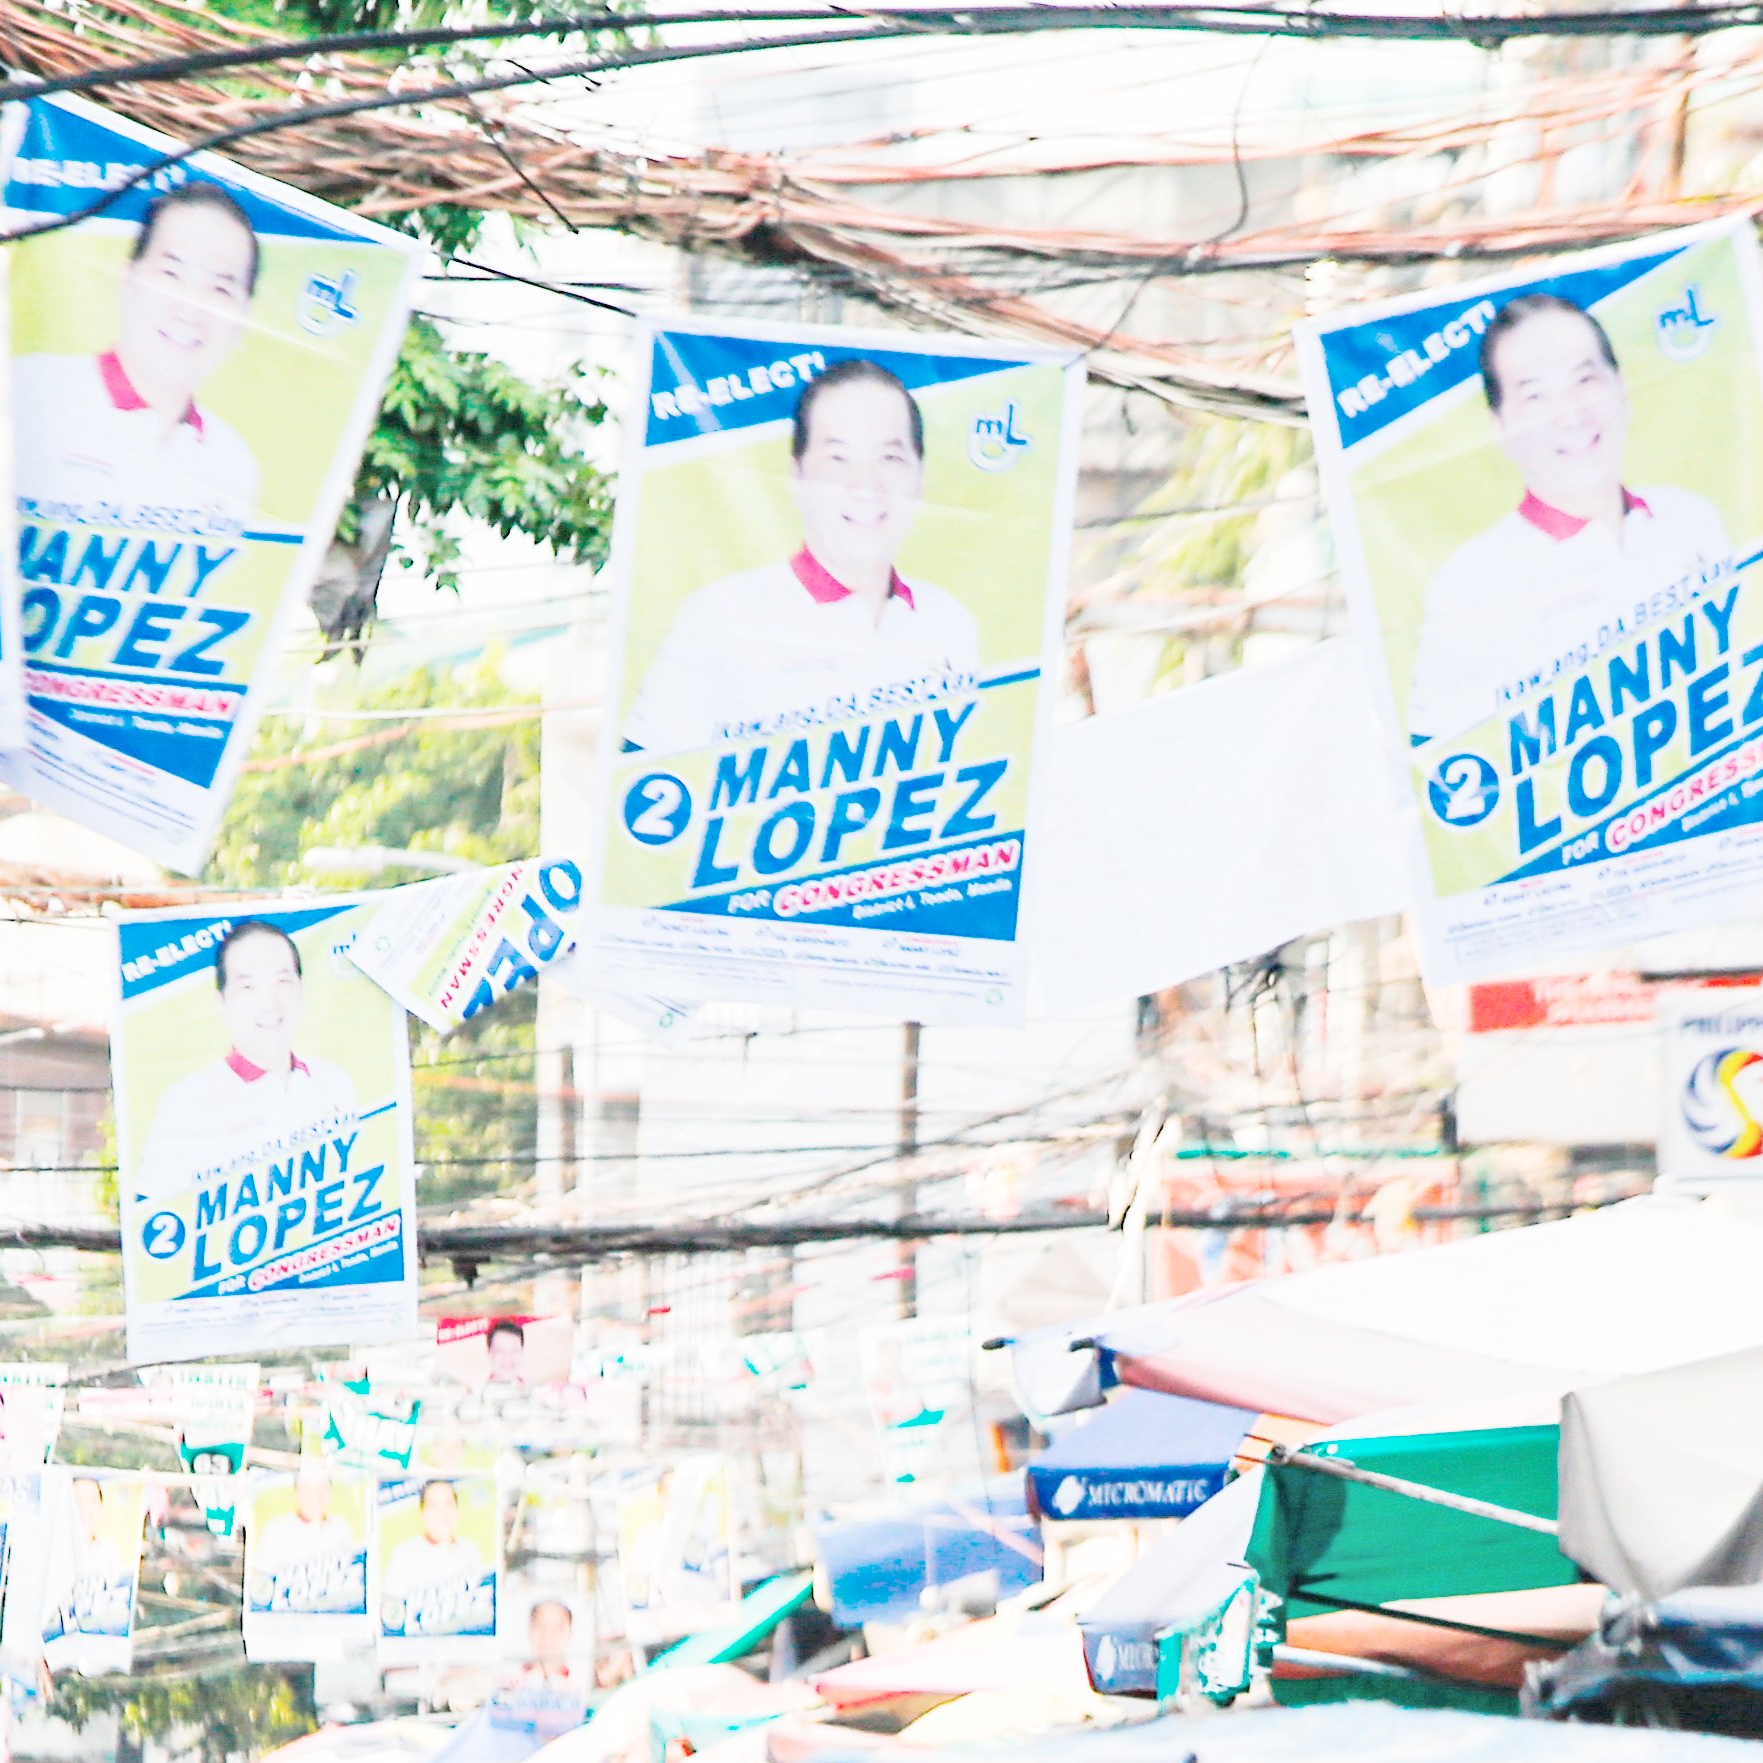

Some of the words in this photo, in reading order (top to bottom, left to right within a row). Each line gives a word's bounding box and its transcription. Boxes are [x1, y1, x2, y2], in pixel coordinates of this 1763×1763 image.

[651, 350, 827, 421] RE-ELECT!
[1337, 300, 1498, 419] RE-ELECT!
[1508, 584, 1741, 777] MANNY
[709, 701, 978, 812] MANNY
[688, 758, 1009, 890] LOPEZ
[778, 844, 1017, 913] CONGRESSMAN
[122, 919, 234, 983] RE-ELECT!
[191, 1164, 386, 1282] LOPEZ
[196, 1130, 359, 1230] MANNY
[249, 1216, 399, 1290] CONGRESSMAN
[1087, 1478, 1210, 1507] MICROMATIC
